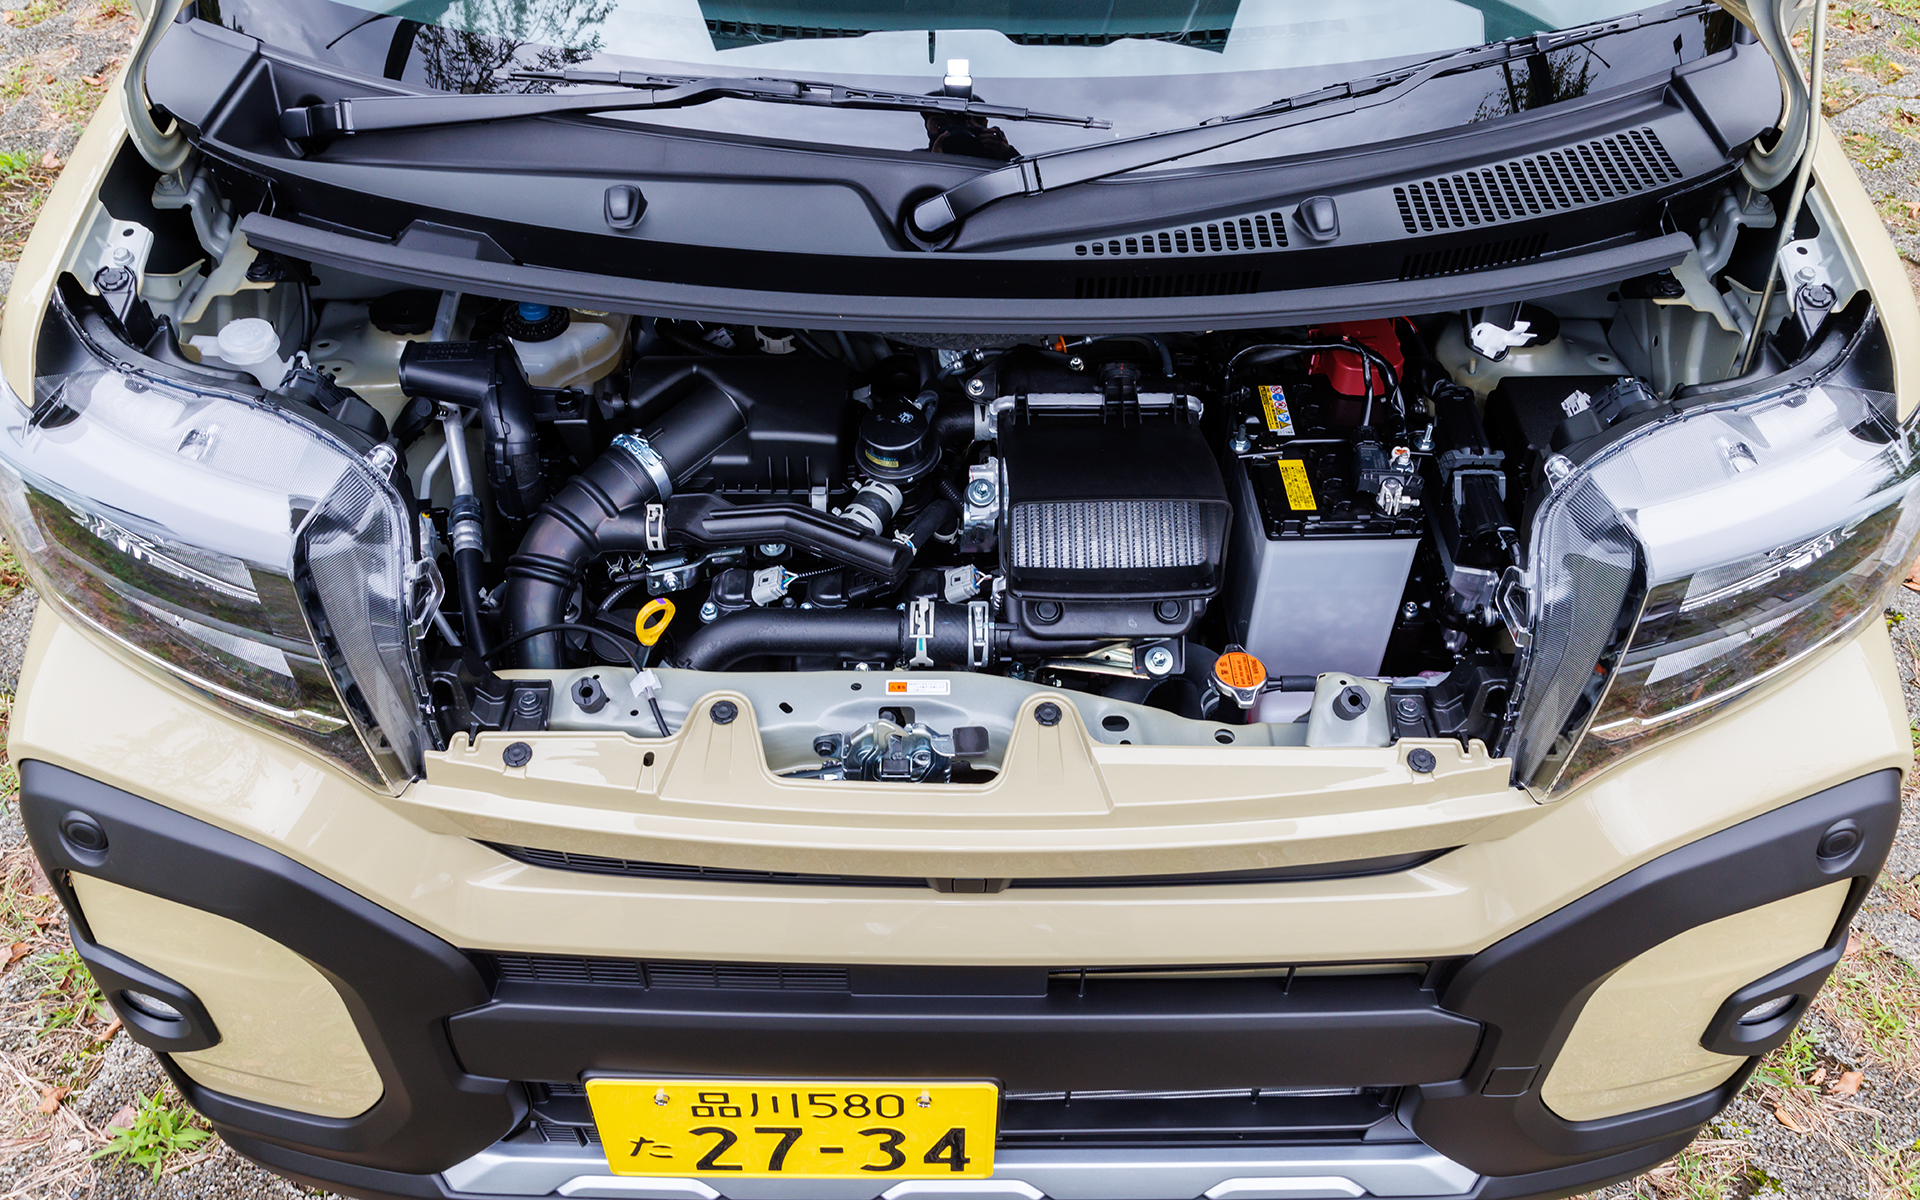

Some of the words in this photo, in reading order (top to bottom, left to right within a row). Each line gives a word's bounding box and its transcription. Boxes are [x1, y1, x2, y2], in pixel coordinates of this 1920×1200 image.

[691, 1092, 905, 1119] 品川580
[630, 1136, 674, 1159] た
[688, 1126, 971, 1172] 27-34
